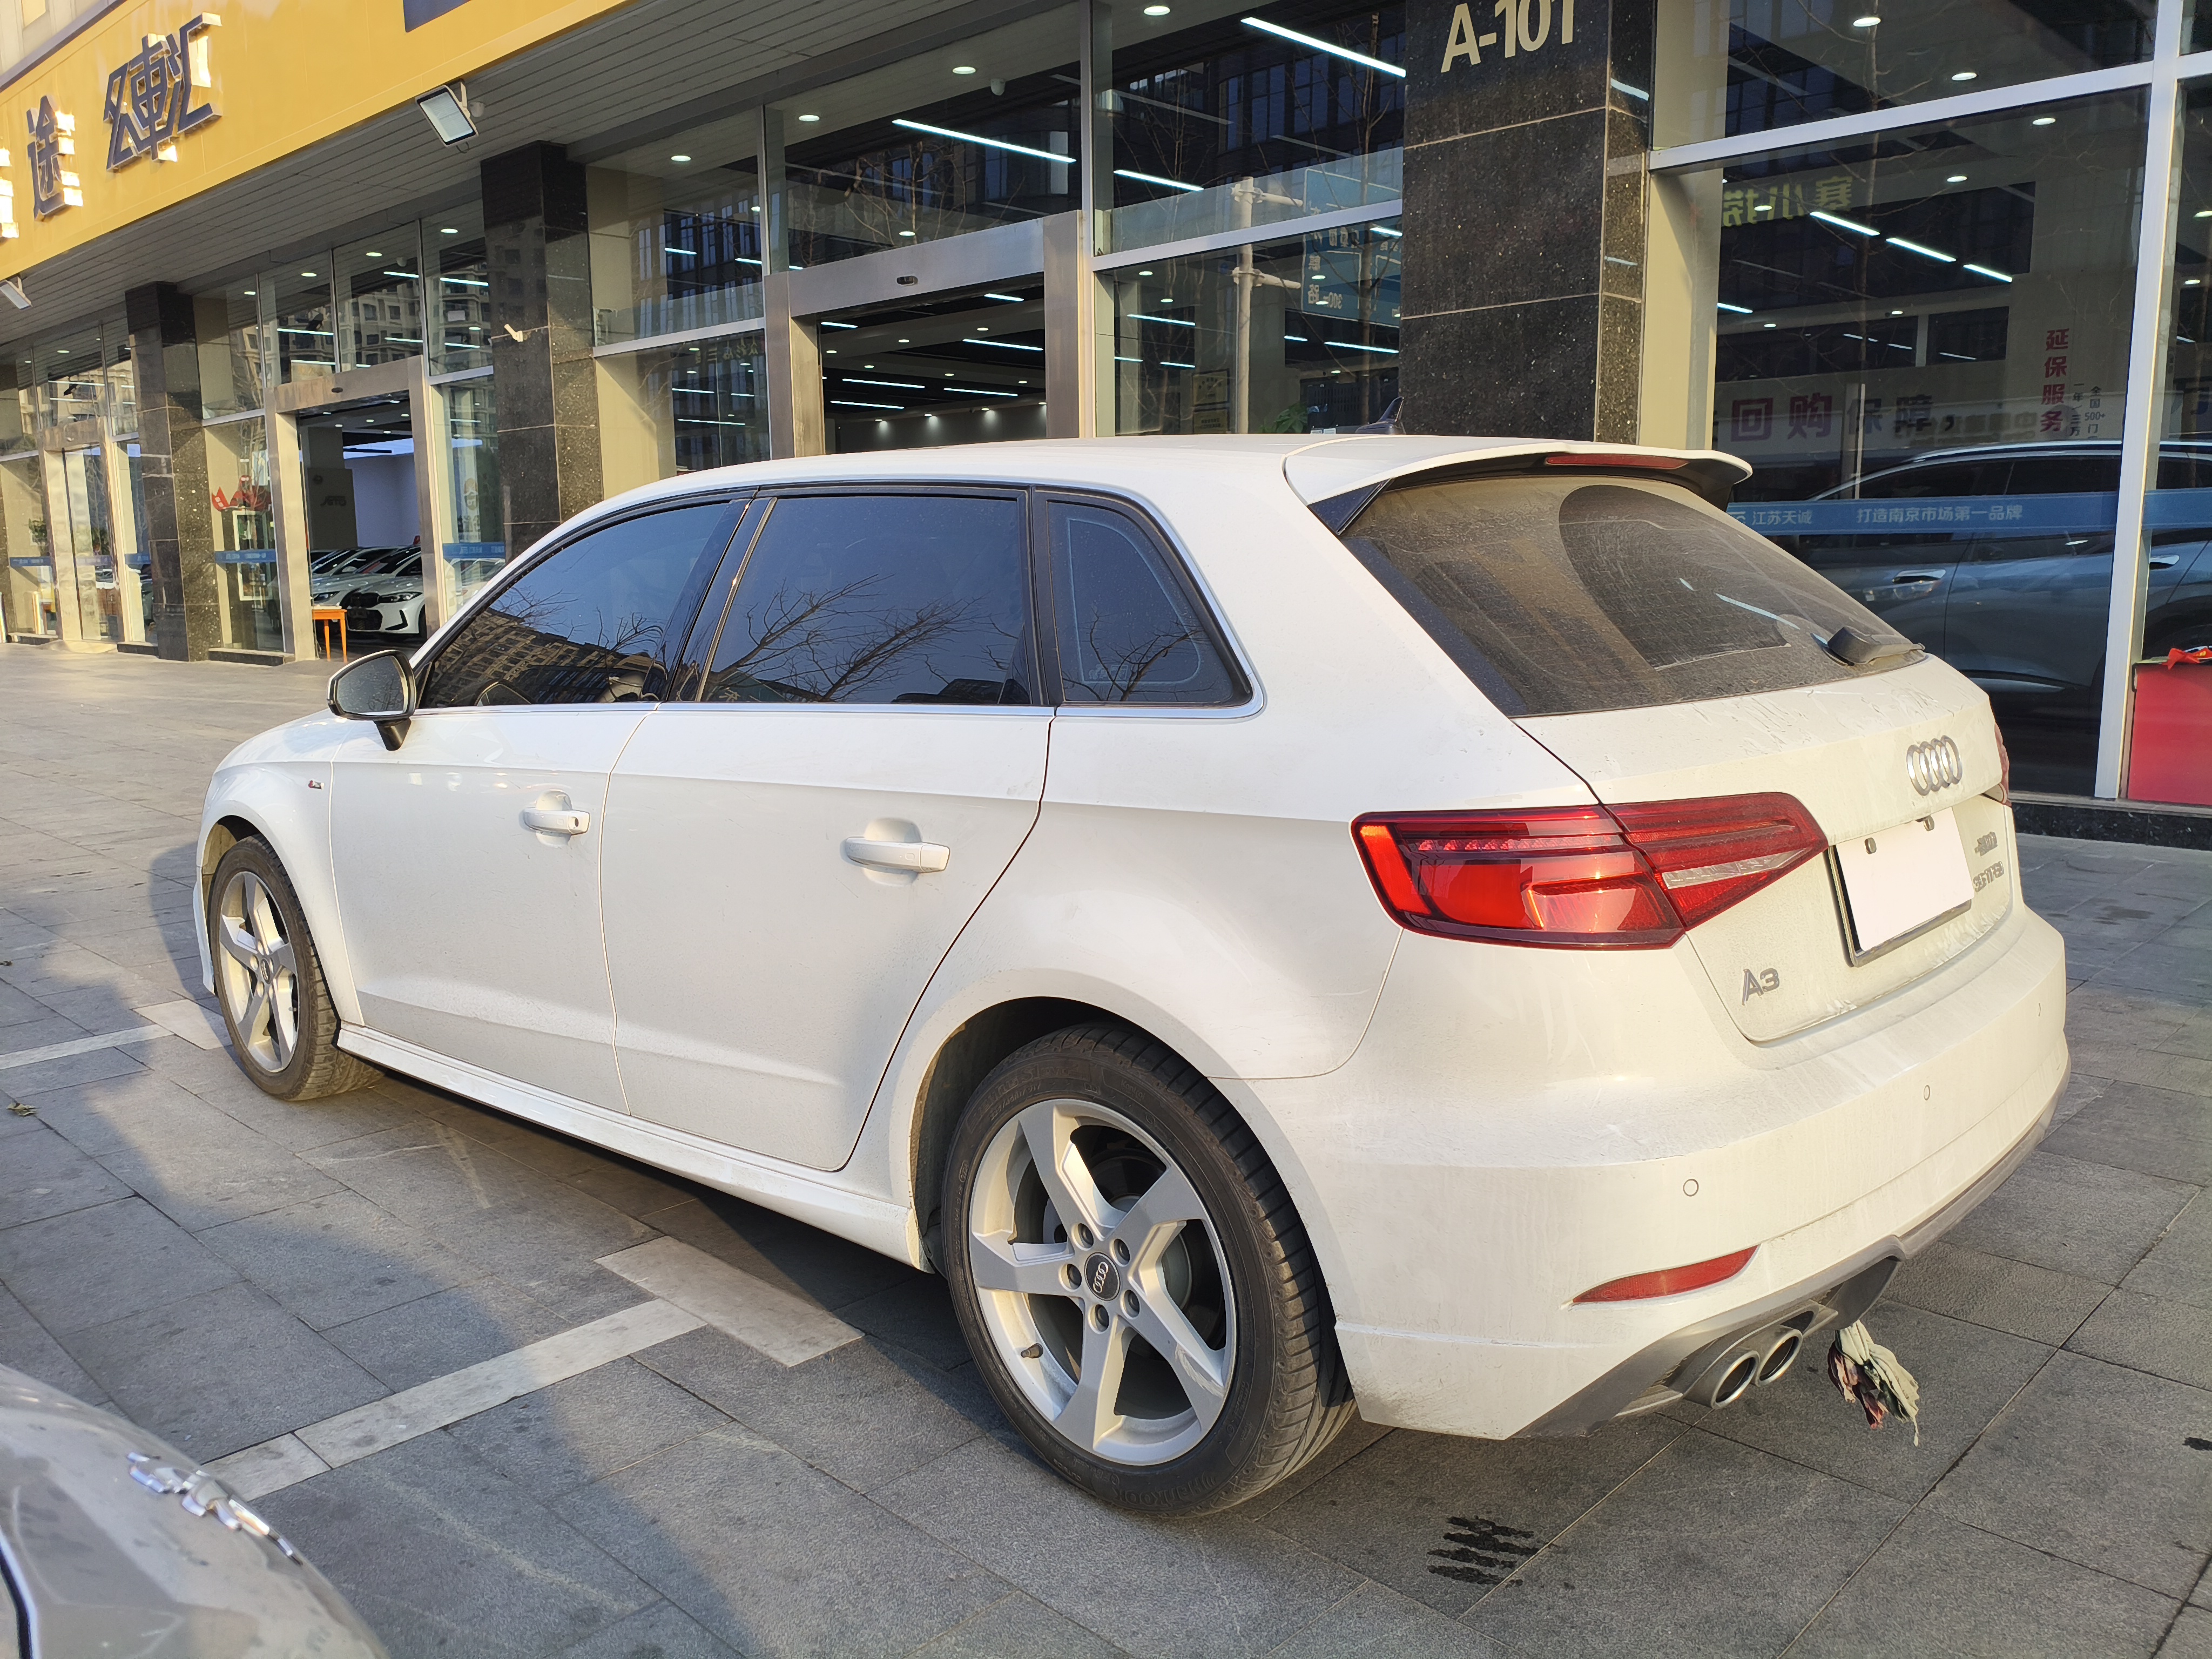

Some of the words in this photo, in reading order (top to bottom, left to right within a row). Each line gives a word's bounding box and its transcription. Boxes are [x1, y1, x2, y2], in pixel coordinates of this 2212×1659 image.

[1440, 0, 1574, 73] A-101
[2040, 328, 2069, 433] 延保服务
[1751, 509, 1812, 525] 江苏天诚
[1857, 504, 2024, 523] 打造南京市场第一品牌
[1742, 967, 1780, 1006] A3
